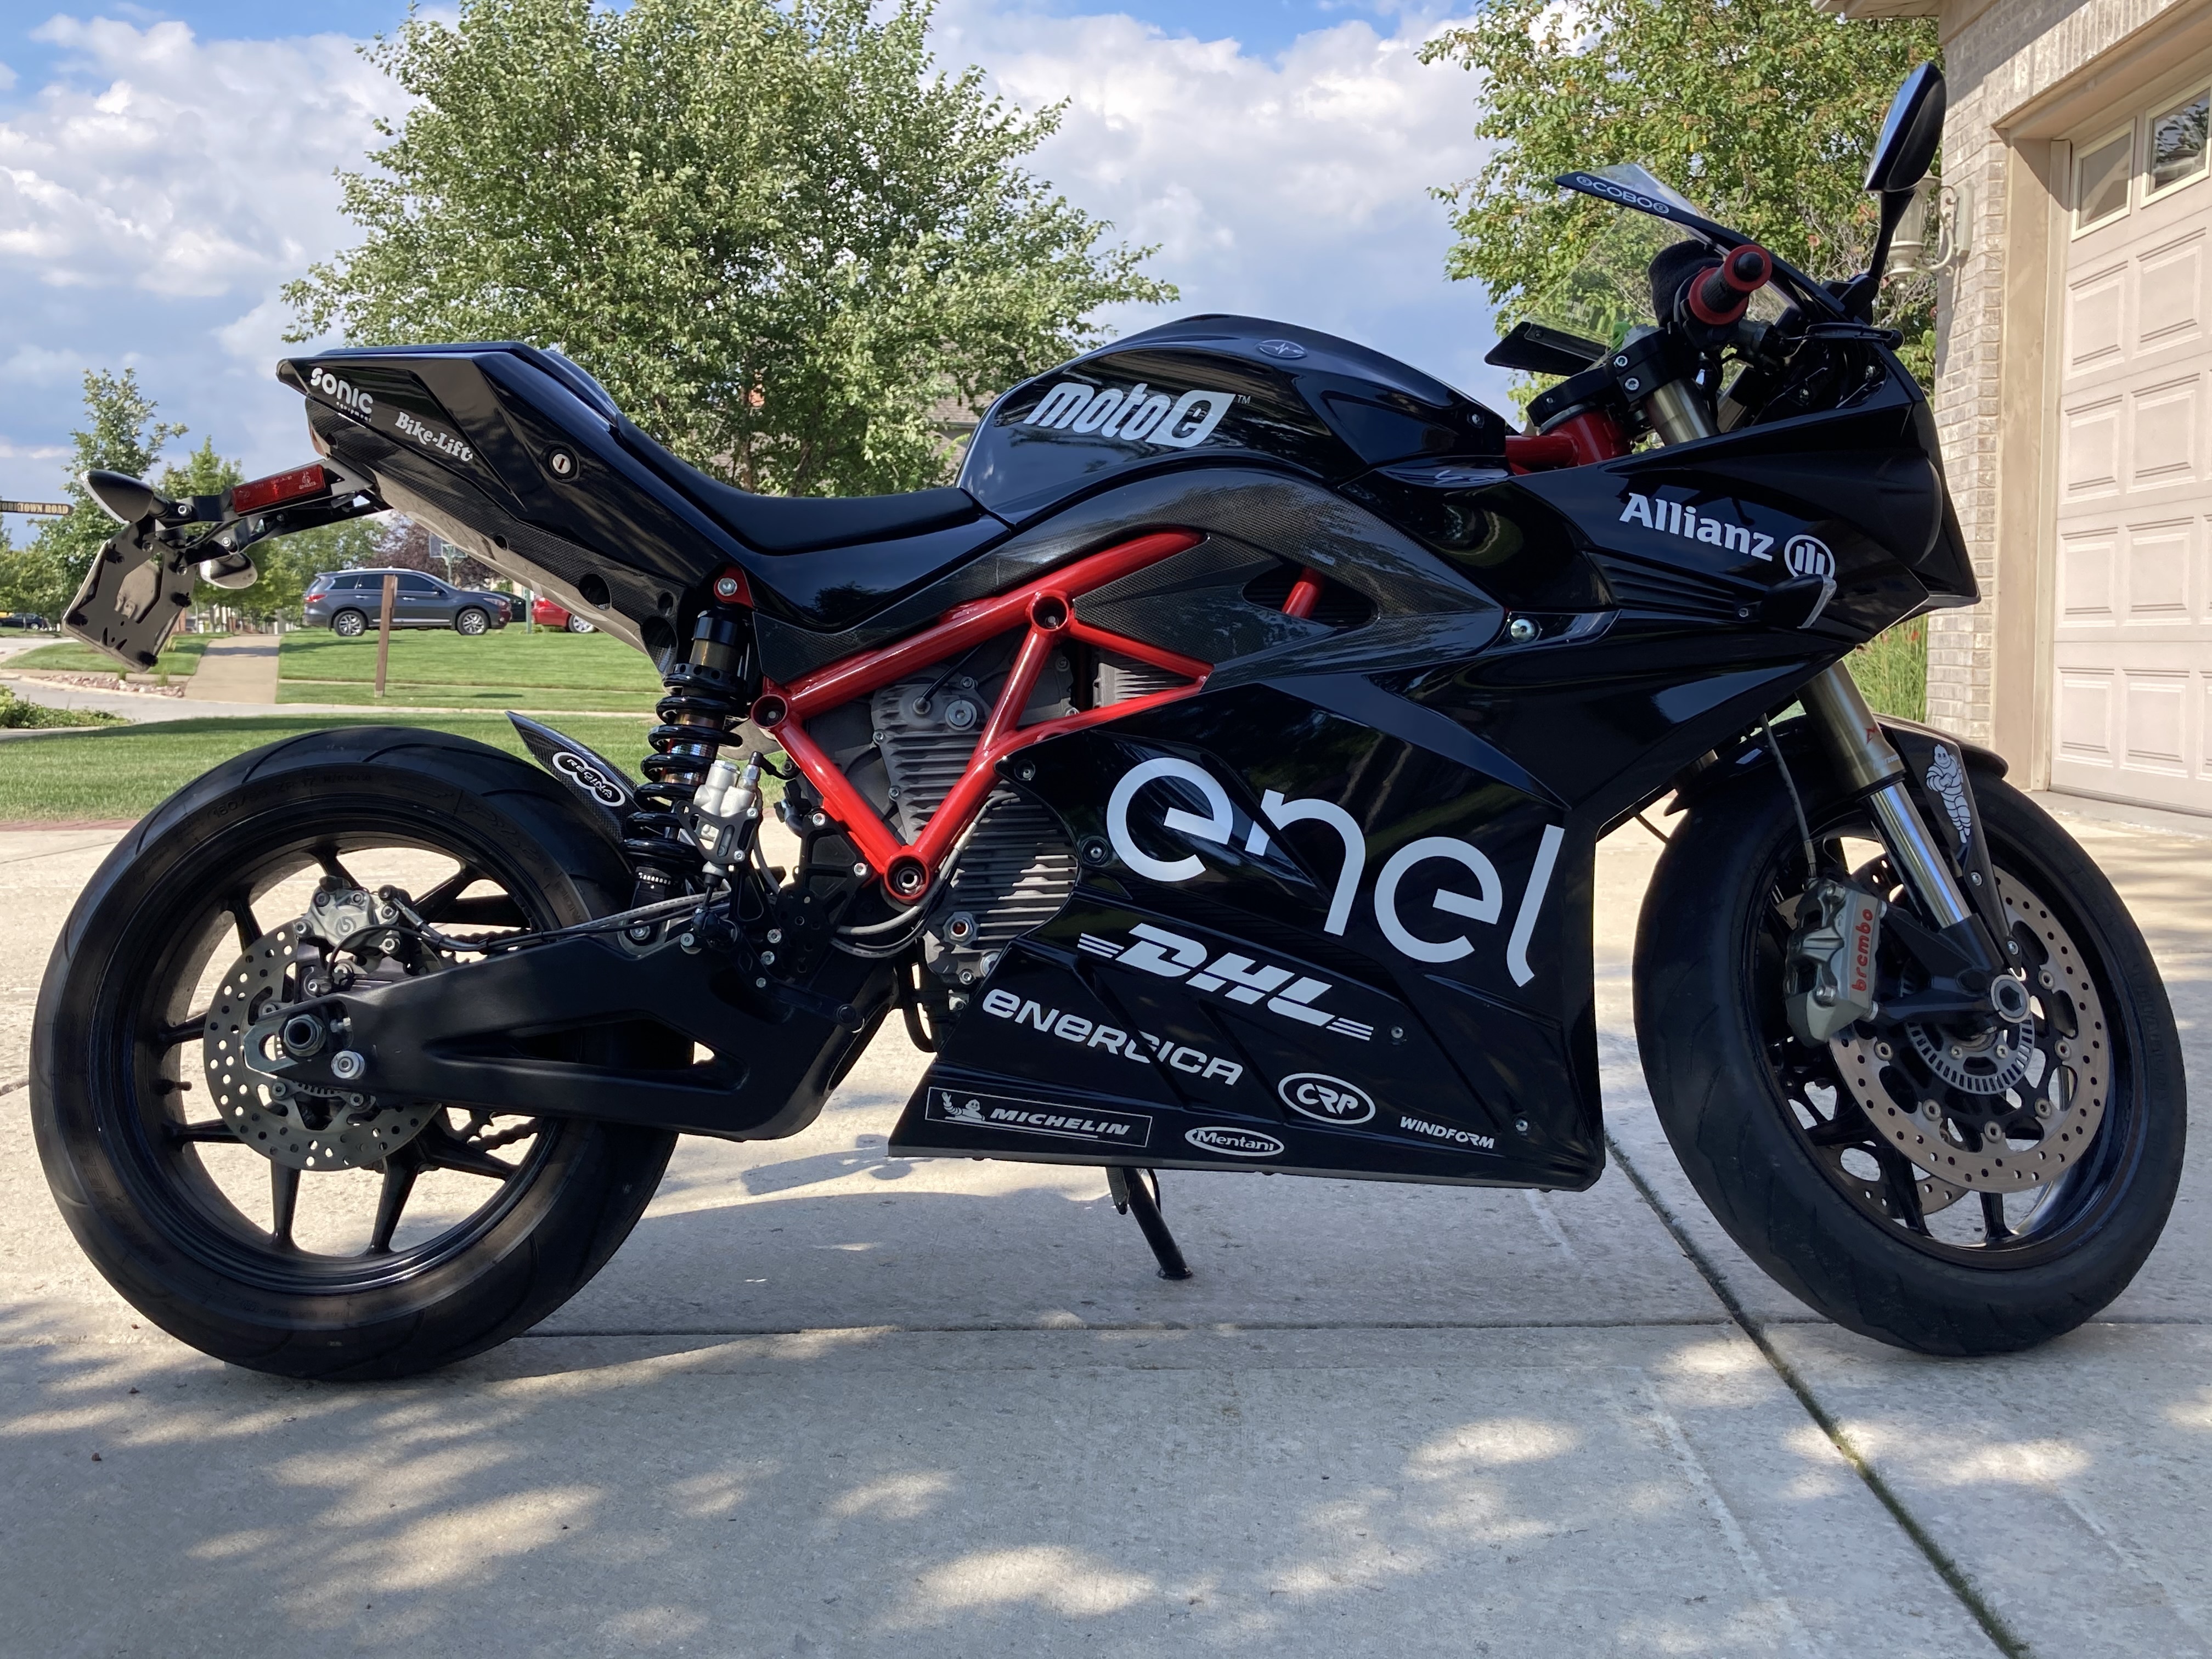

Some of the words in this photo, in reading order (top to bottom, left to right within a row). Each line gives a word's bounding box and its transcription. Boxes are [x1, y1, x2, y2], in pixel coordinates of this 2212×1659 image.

[1593, 182, 1653, 208] COBO
[395, 411, 473, 461] Bike-Lift
[45, 504, 69, 514] ROAD
[1619, 493, 1774, 561] Allianz
[567, 759, 612, 798] REGINA
[1106, 757, 1565, 987] enel
[1852, 909, 1873, 992] brembo
[1115, 922, 1335, 1026] DHL
[1296, 1083, 1358, 1114] CRP
[990, 1107, 1130, 1135] MICHELIN
[1400, 1116, 1494, 1149] WINDFORM
[1194, 1130, 1274, 1151] Mentani
